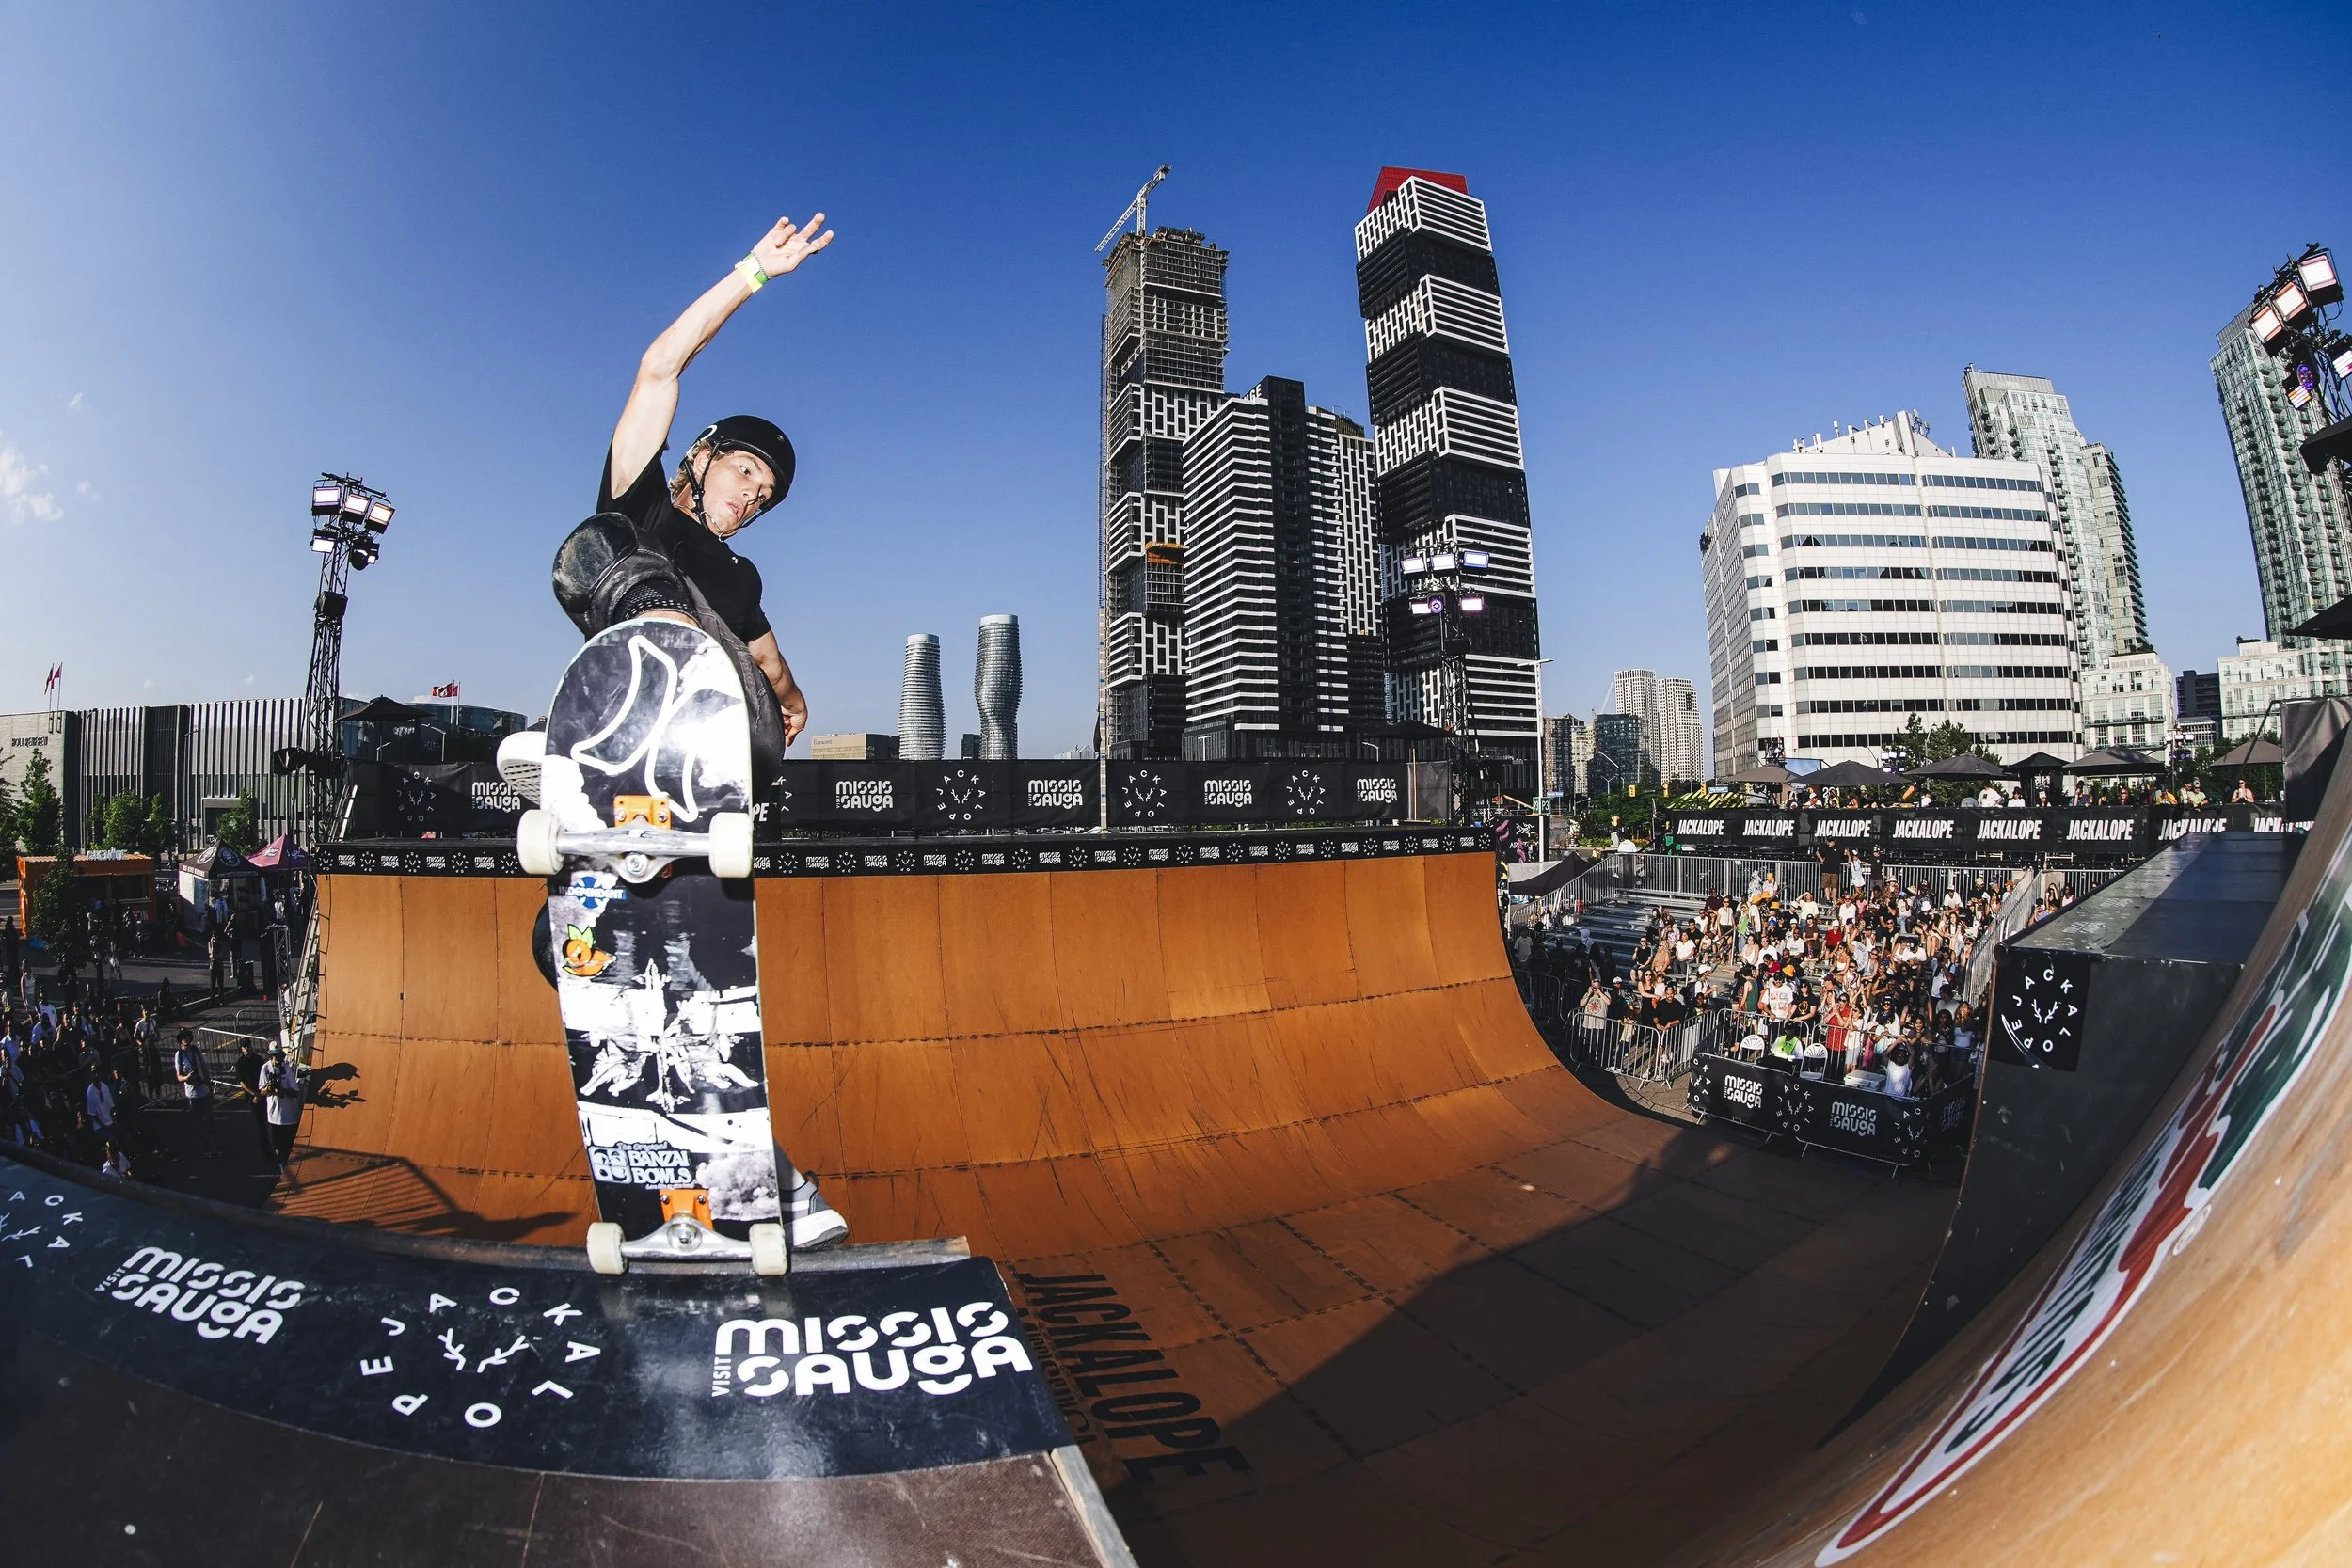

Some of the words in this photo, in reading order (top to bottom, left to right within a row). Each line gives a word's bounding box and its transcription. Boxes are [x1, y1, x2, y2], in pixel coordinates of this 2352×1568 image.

[936, 769, 986, 821] JACKALOPE
[1121, 769, 1168, 818] JACKALOPE
[1286, 769, 1326, 815] JACKALOPE
[1541, 800, 1549, 810] P3
[1676, 819, 1724, 835] JACKALOPE
[1742, 819, 1795, 836] JACKALOPE
[1814, 819, 1871, 838] JACKALOPE
[1892, 819, 1955, 839] JACKALOPE
[1977, 819, 2042, 840] JACKALOPE
[2066, 819, 2135, 841] JACKALOPE
[2011, 969, 2078, 1052] JACKALOPE
[628, 1150, 691, 1167] BANZAI
[631, 1167, 693, 1184] BOWLS
[95, 1267, 126, 1292] VISIT
[122, 1246, 306, 1310] MISSIS
[715, 1301, 1009, 1355] MISSIS
[360, 1287, 601, 1428] JACKALOPE
[737, 1336, 1033, 1398] SAUGA
[711, 1355, 732, 1398] VISIT
[1015, 1273, 1253, 1485] JACKALOPE
